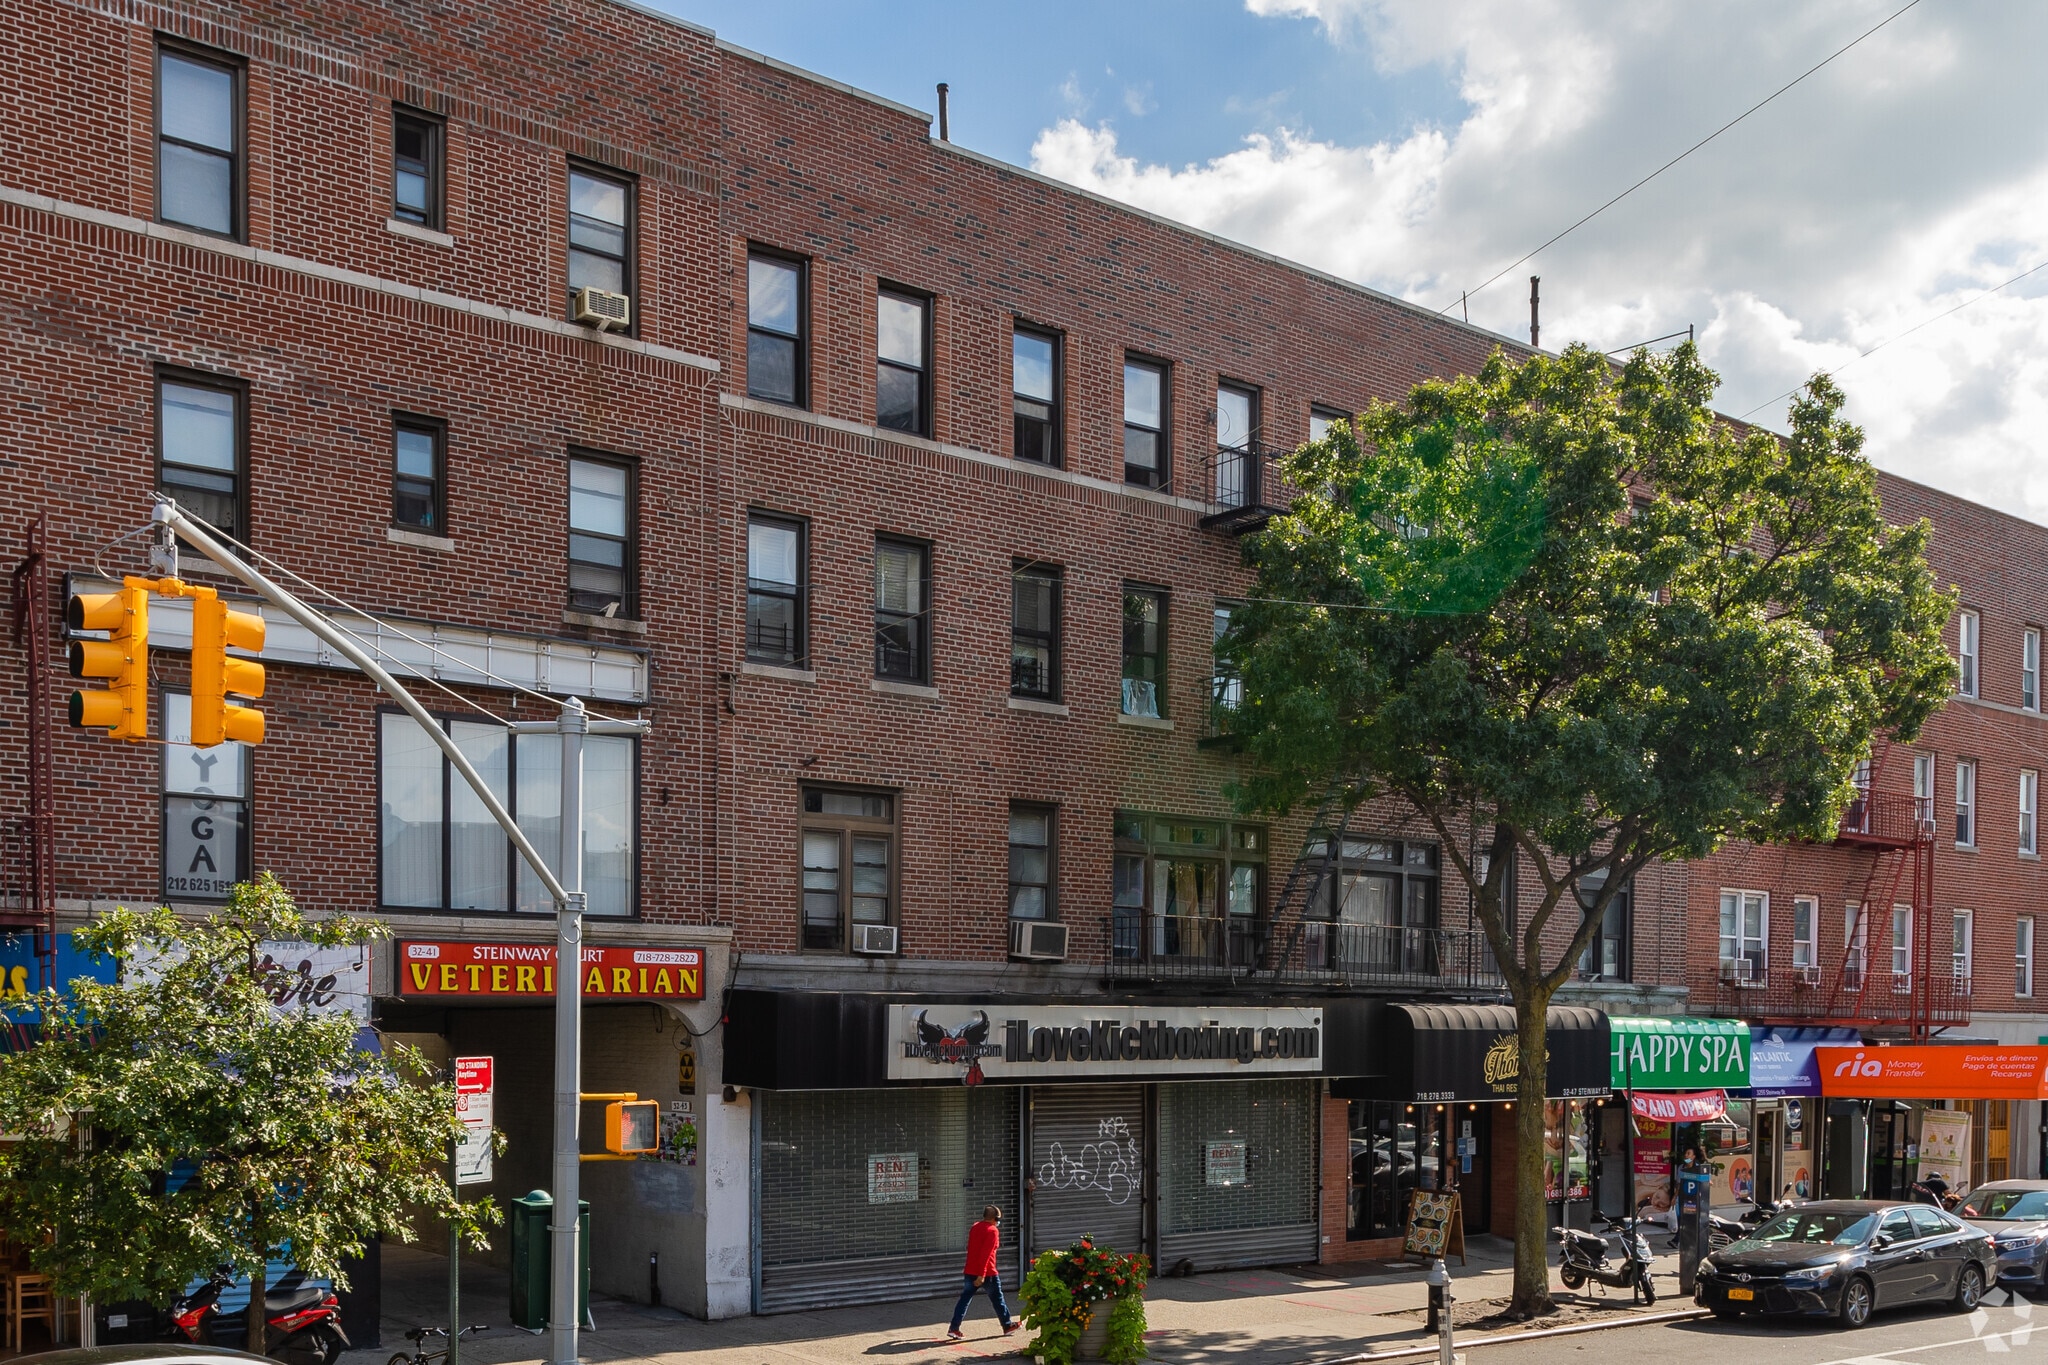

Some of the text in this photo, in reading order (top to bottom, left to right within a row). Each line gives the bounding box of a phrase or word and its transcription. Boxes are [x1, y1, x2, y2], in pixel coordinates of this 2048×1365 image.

[188, 752, 218, 873] YOGA
[167, 876, 187, 891] 212
[189, 878, 211, 892] 625
[411, 946, 605, 963] 32-41 STEINWAY URT
[637, 952, 695, 963] 718-728-2822
[410, 963, 698, 994] VETERIARIAN
[1005, 1019, 1319, 1064] iLoveKickboxing.com
[1699, 1035, 1745, 1073] SPA
[1752, 1051, 1793, 1063] ATLANTIC
[465, 1061, 488, 1069] STANDING
[1834, 1052, 1883, 1077] ria
[1887, 1060, 1923, 1070] Money
[1962, 1062, 1985, 1071] Pago
[458, 1070, 477, 1079] Anytime
[1885, 1069, 1926, 1077] Transfer
[1990, 1070, 2033, 1079] Recargas
[1680, 1095, 1723, 1117] OPENING
[876, 1161, 909, 1173] RENT
[1687, 1181, 1696, 1194] P
